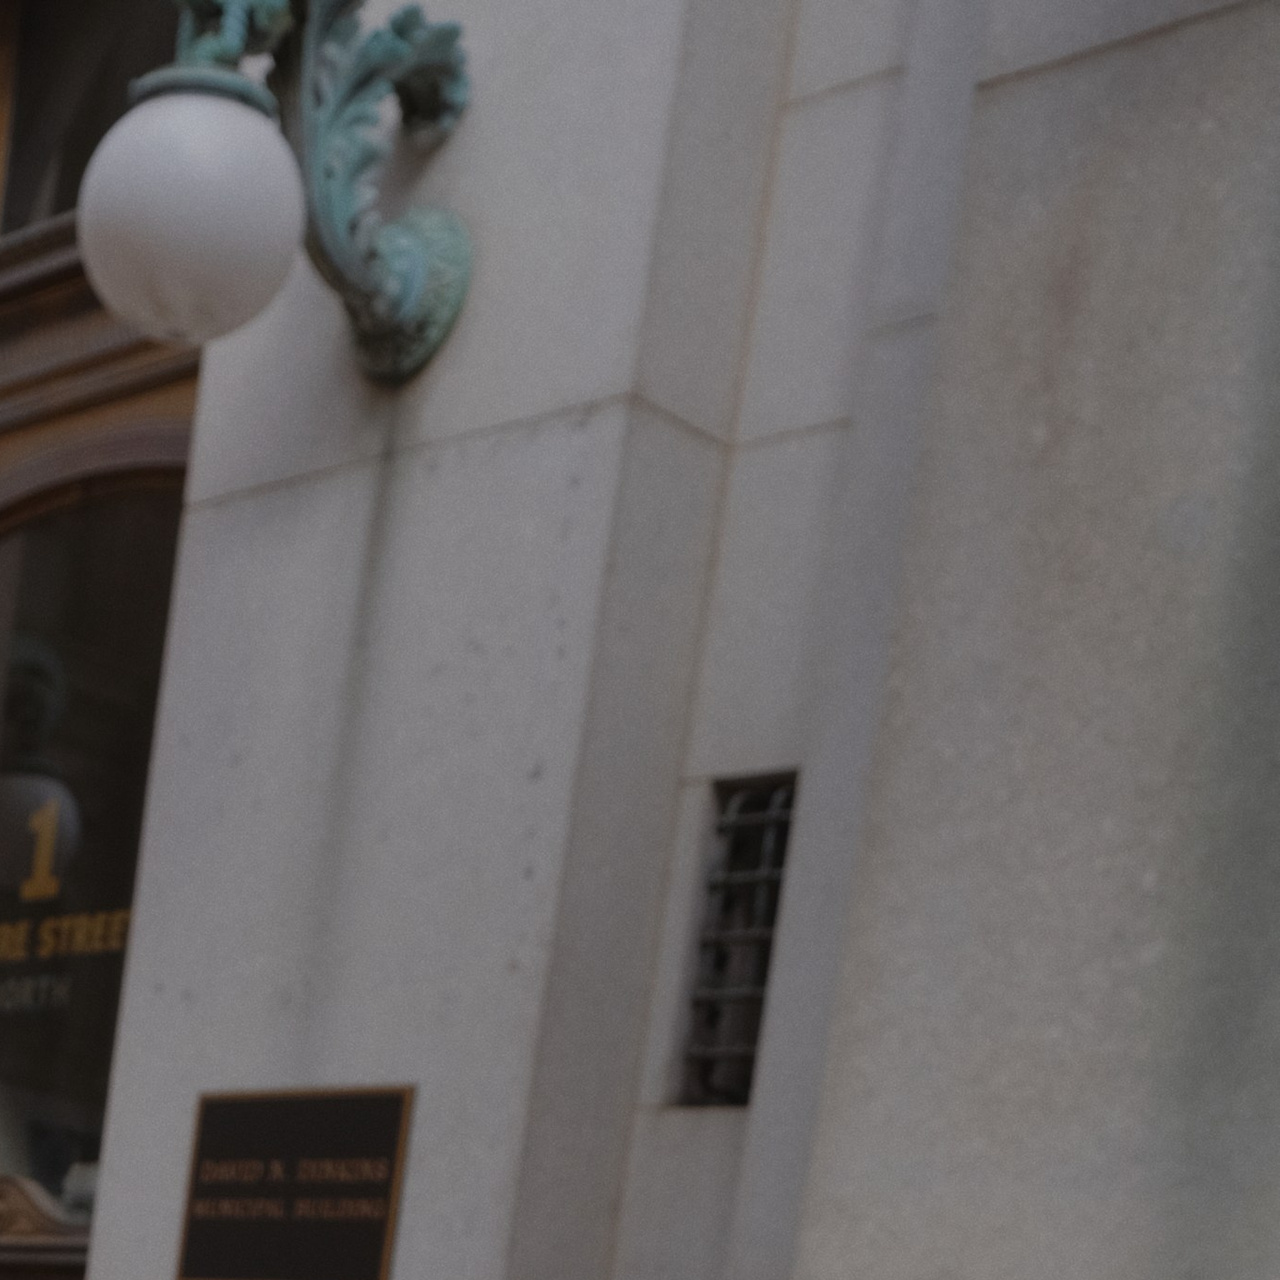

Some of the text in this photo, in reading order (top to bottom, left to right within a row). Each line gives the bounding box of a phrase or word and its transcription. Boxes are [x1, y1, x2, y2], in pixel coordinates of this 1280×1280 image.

[20, 798, 60, 900] 1
[38, 908, 132, 959] STREE
[200, 1158, 264, 1183] DAVID
